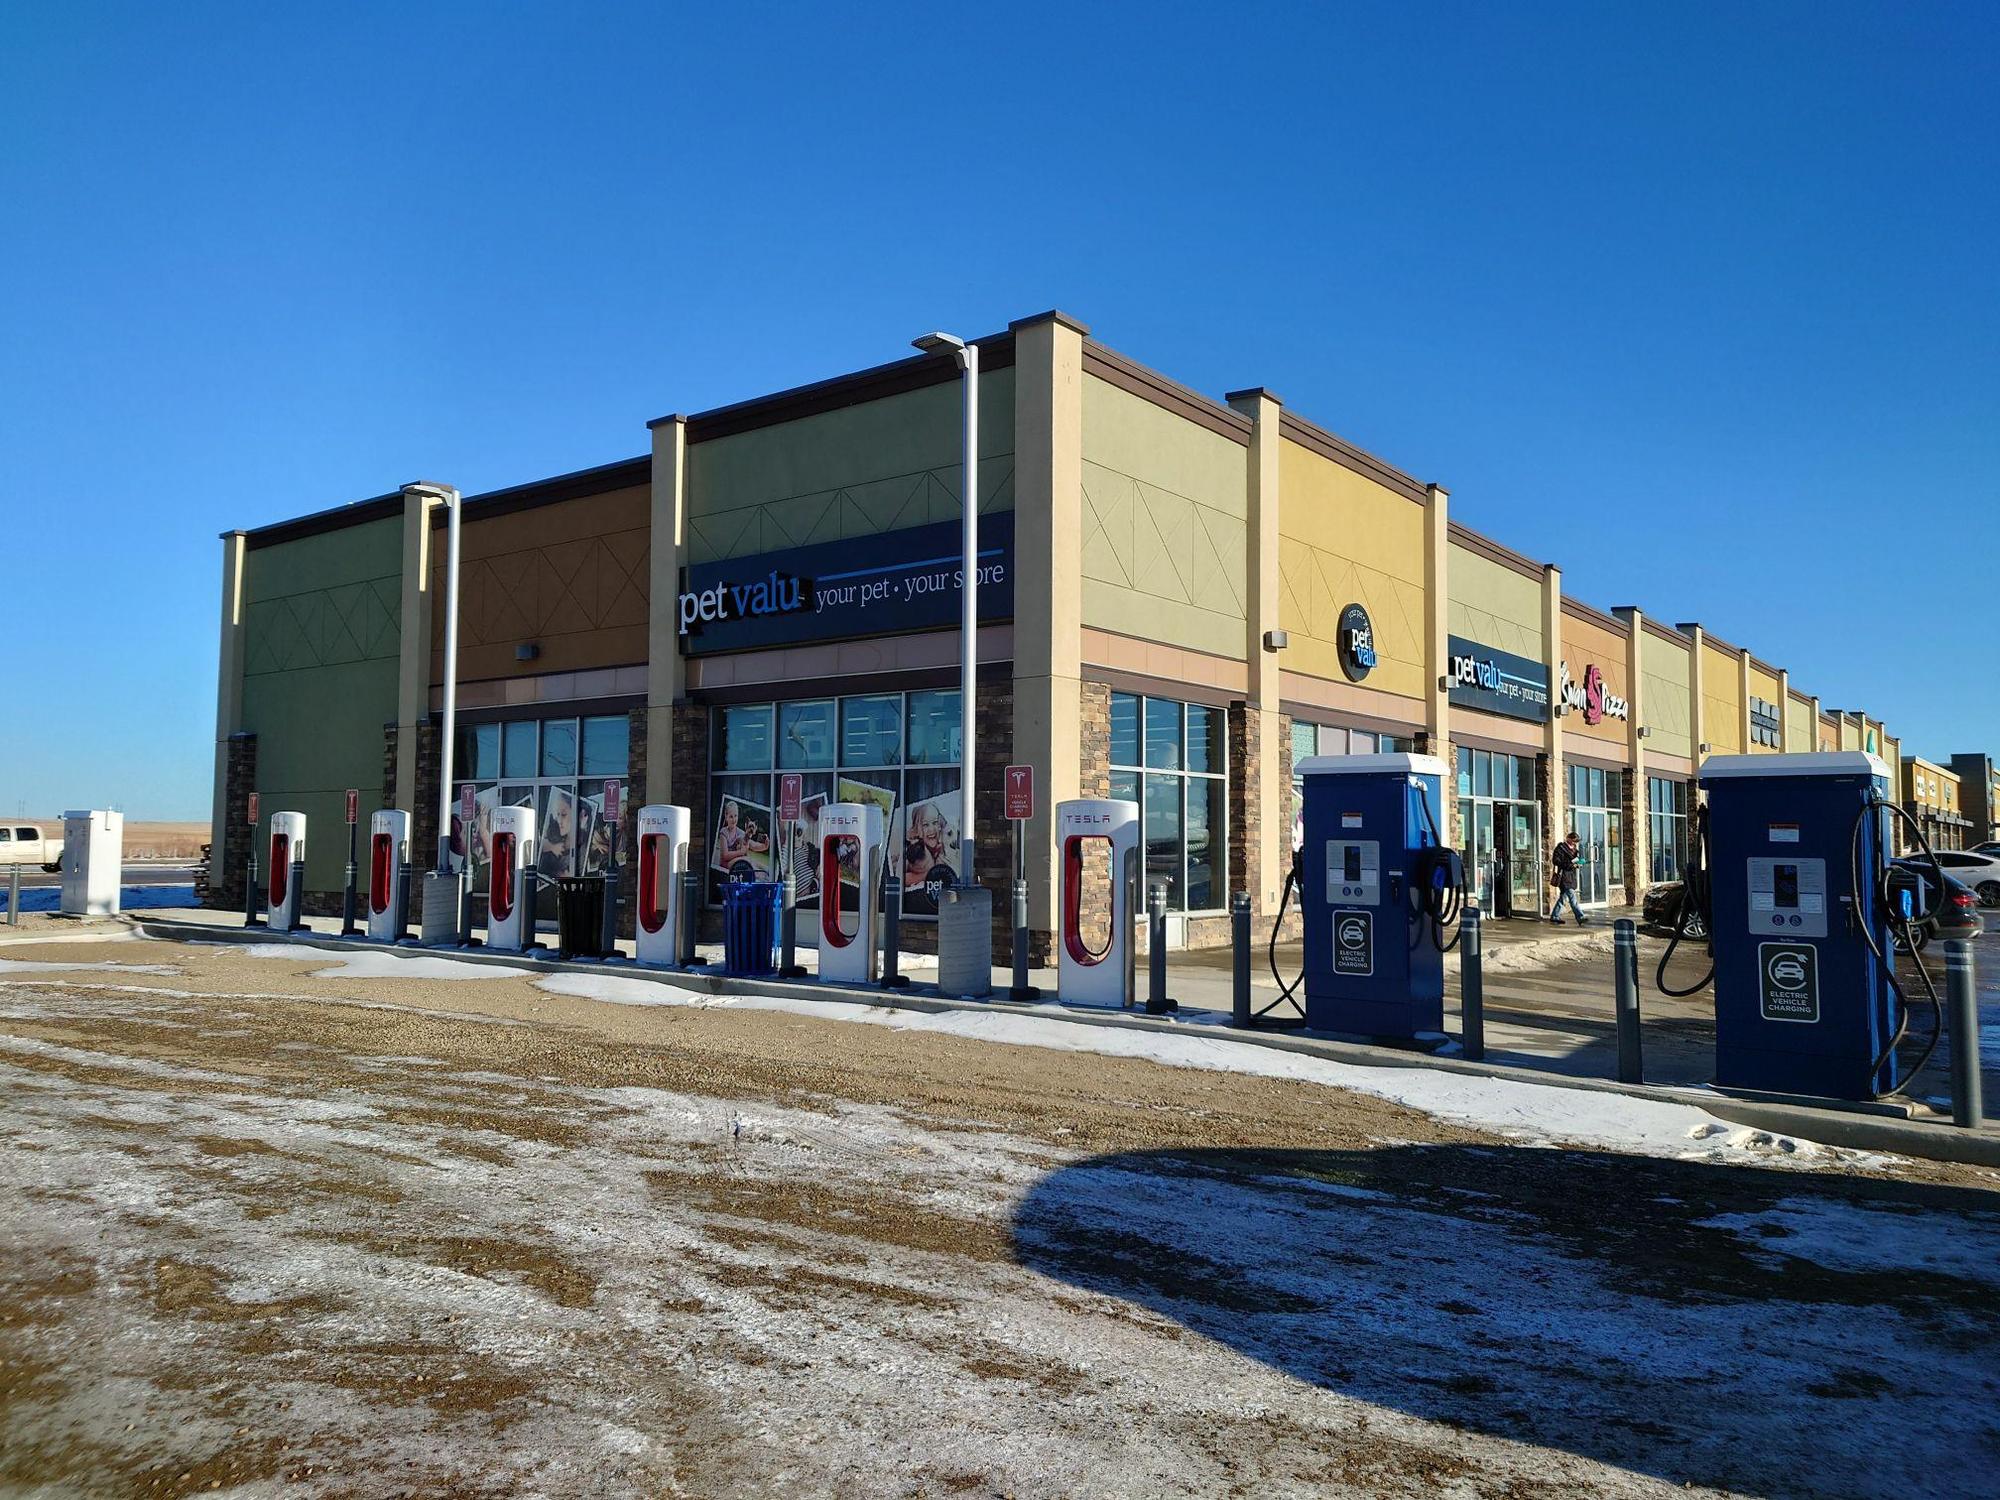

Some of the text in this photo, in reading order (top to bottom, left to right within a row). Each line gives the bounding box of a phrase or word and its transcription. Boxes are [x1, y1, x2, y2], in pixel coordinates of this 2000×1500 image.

[816, 565, 1004, 613] your pet your sore
[679, 570, 801, 634] pet valu
[1351, 628, 1369, 651] pet
[1356, 646, 1377, 667] valu
[1454, 655, 1501, 690] pet valu
[824, 816, 859, 825] TESLA
[1066, 815, 1111, 823] TESLA
[926, 879, 944, 894] pet
[1339, 949, 1367, 957] ELECTRIC
[1769, 991, 1809, 999] ELECTRIC
[1772, 998, 1808, 1006] VEHICLE
[1767, 1004, 1812, 1013] CHARGING
